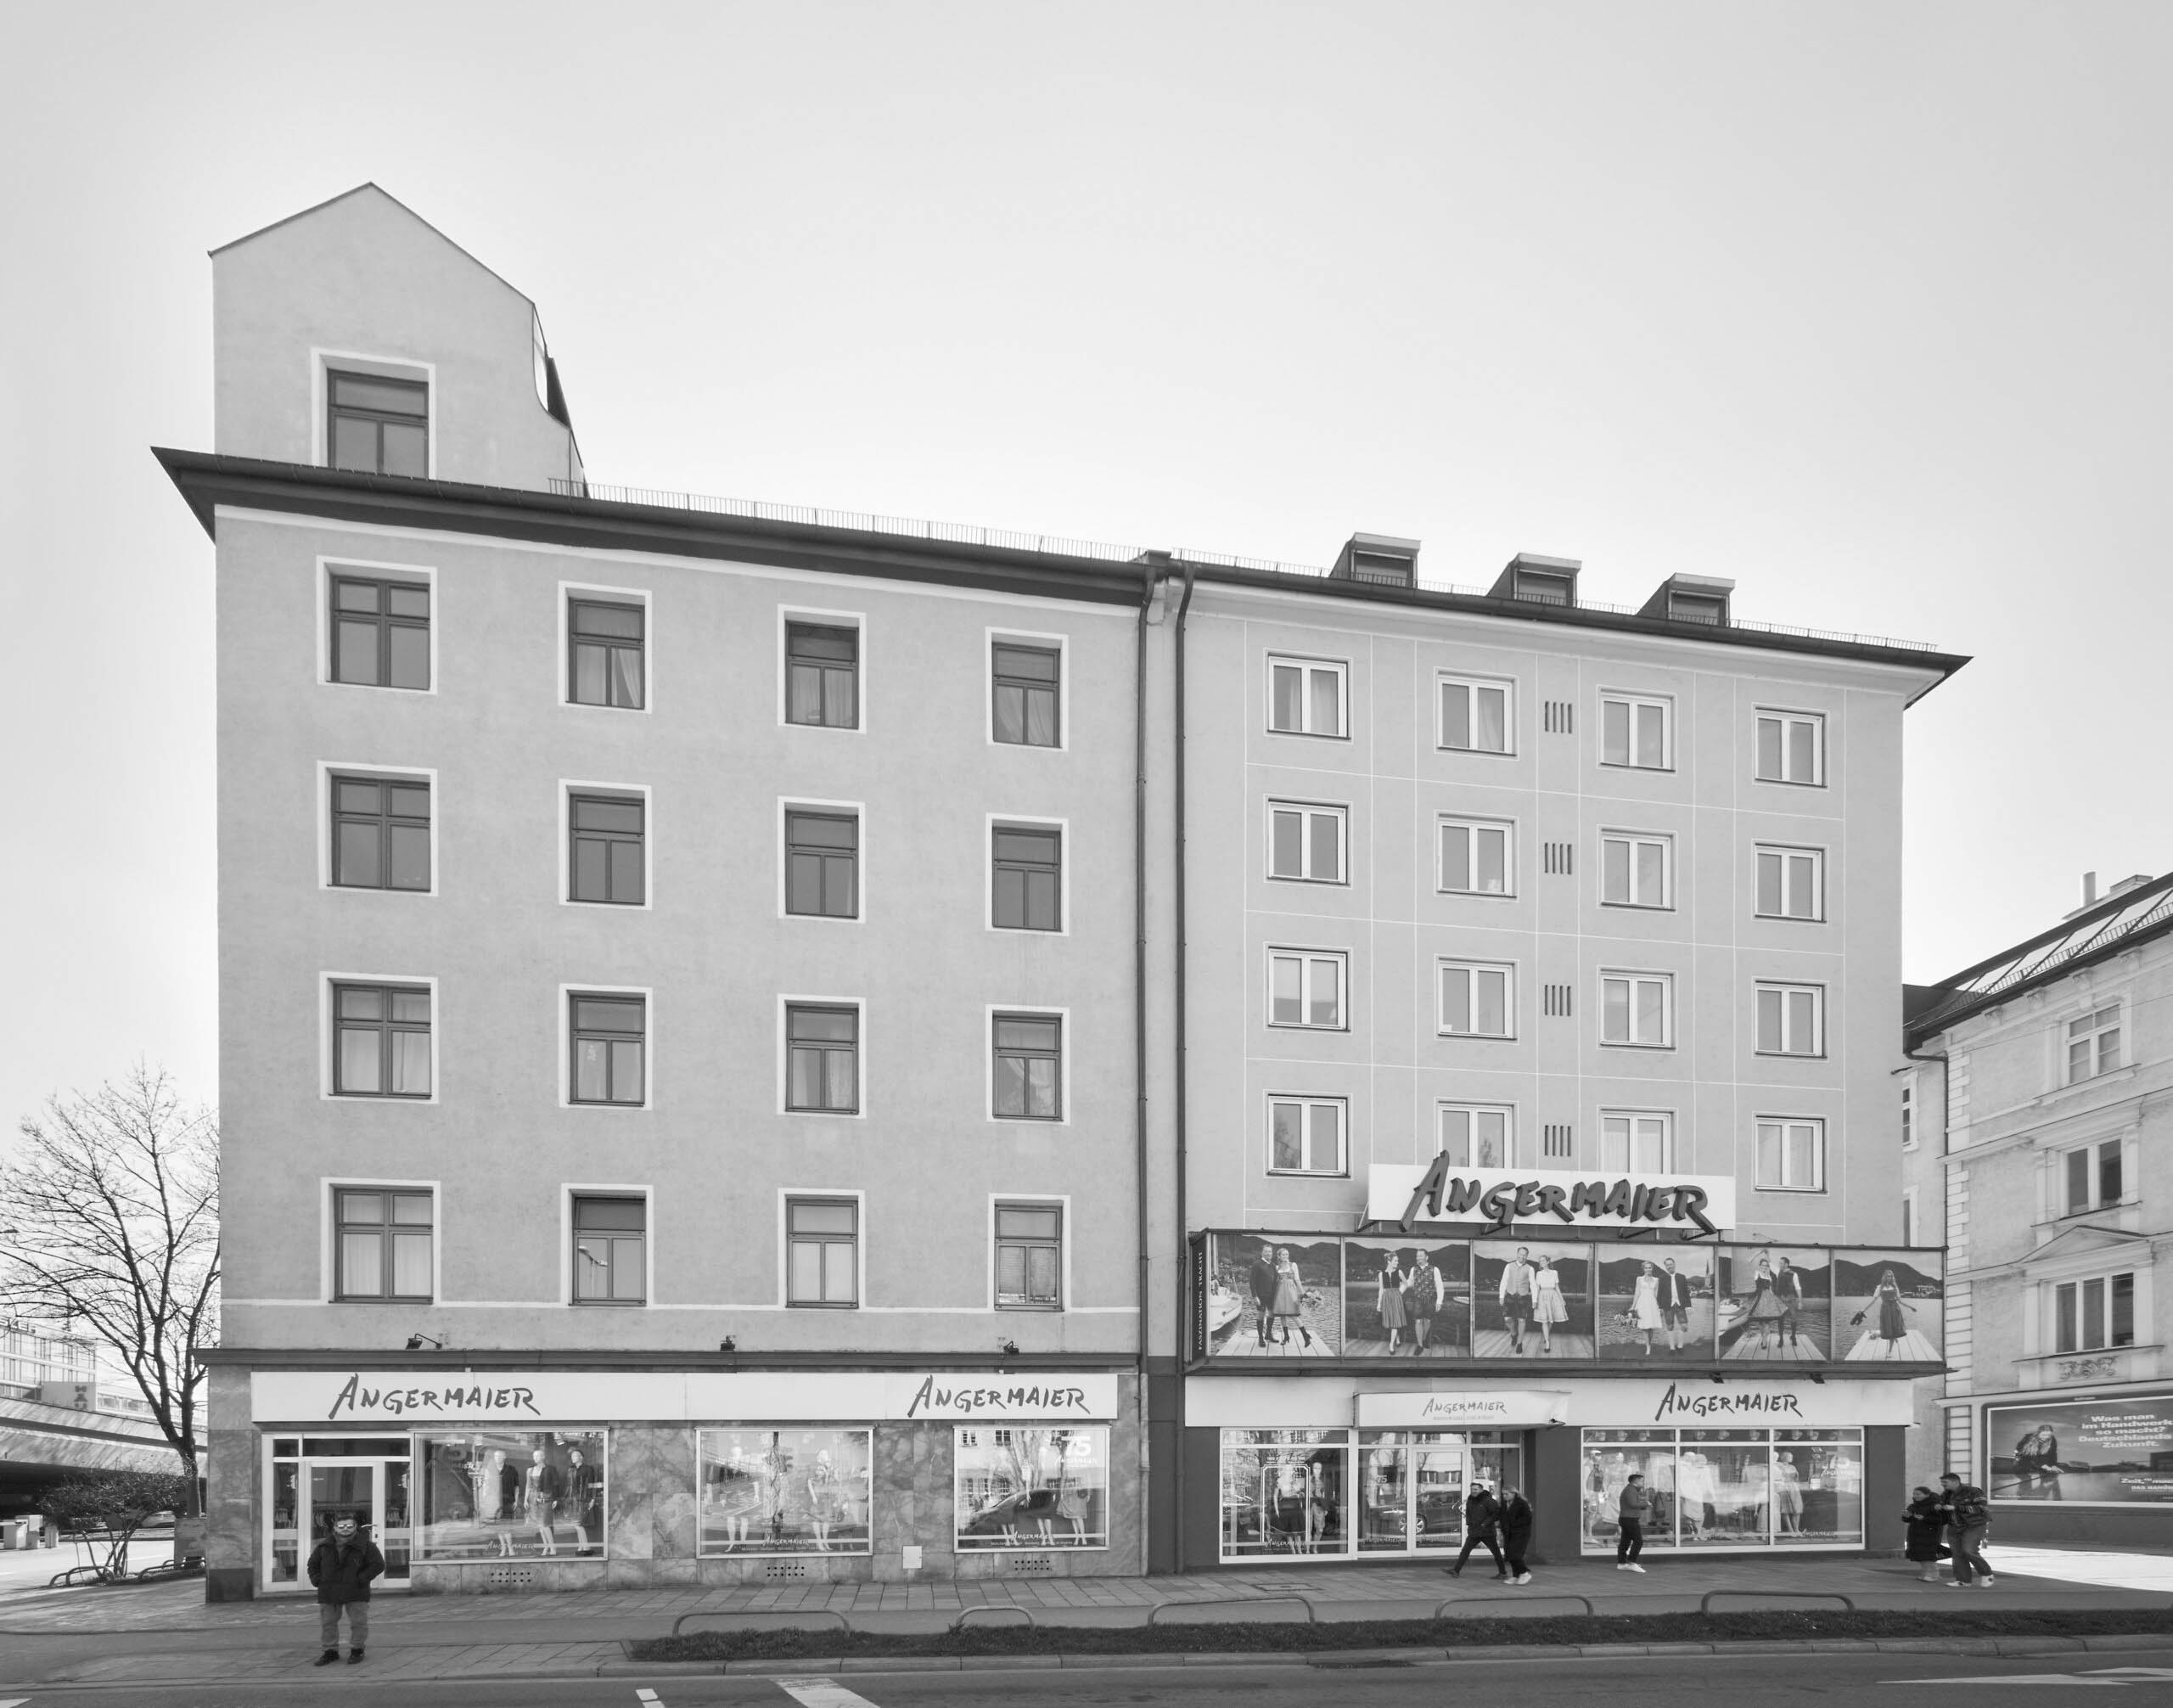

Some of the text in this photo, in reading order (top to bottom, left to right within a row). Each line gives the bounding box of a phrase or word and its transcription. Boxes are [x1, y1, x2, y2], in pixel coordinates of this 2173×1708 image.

[1399, 1149, 1717, 1235] ANGERMAIER
[328, 1372, 542, 1419] ANGERMAIER
[907, 1374, 1091, 1419] ANGERMAIER
[1422, 1396, 1508, 1417] ANGERMAIER
[1654, 1380, 1803, 1421] ANGERMAIER
[2078, 1434, 2172, 1442] Deutschlands
[485, 1540, 536, 1551] ANMAIER
